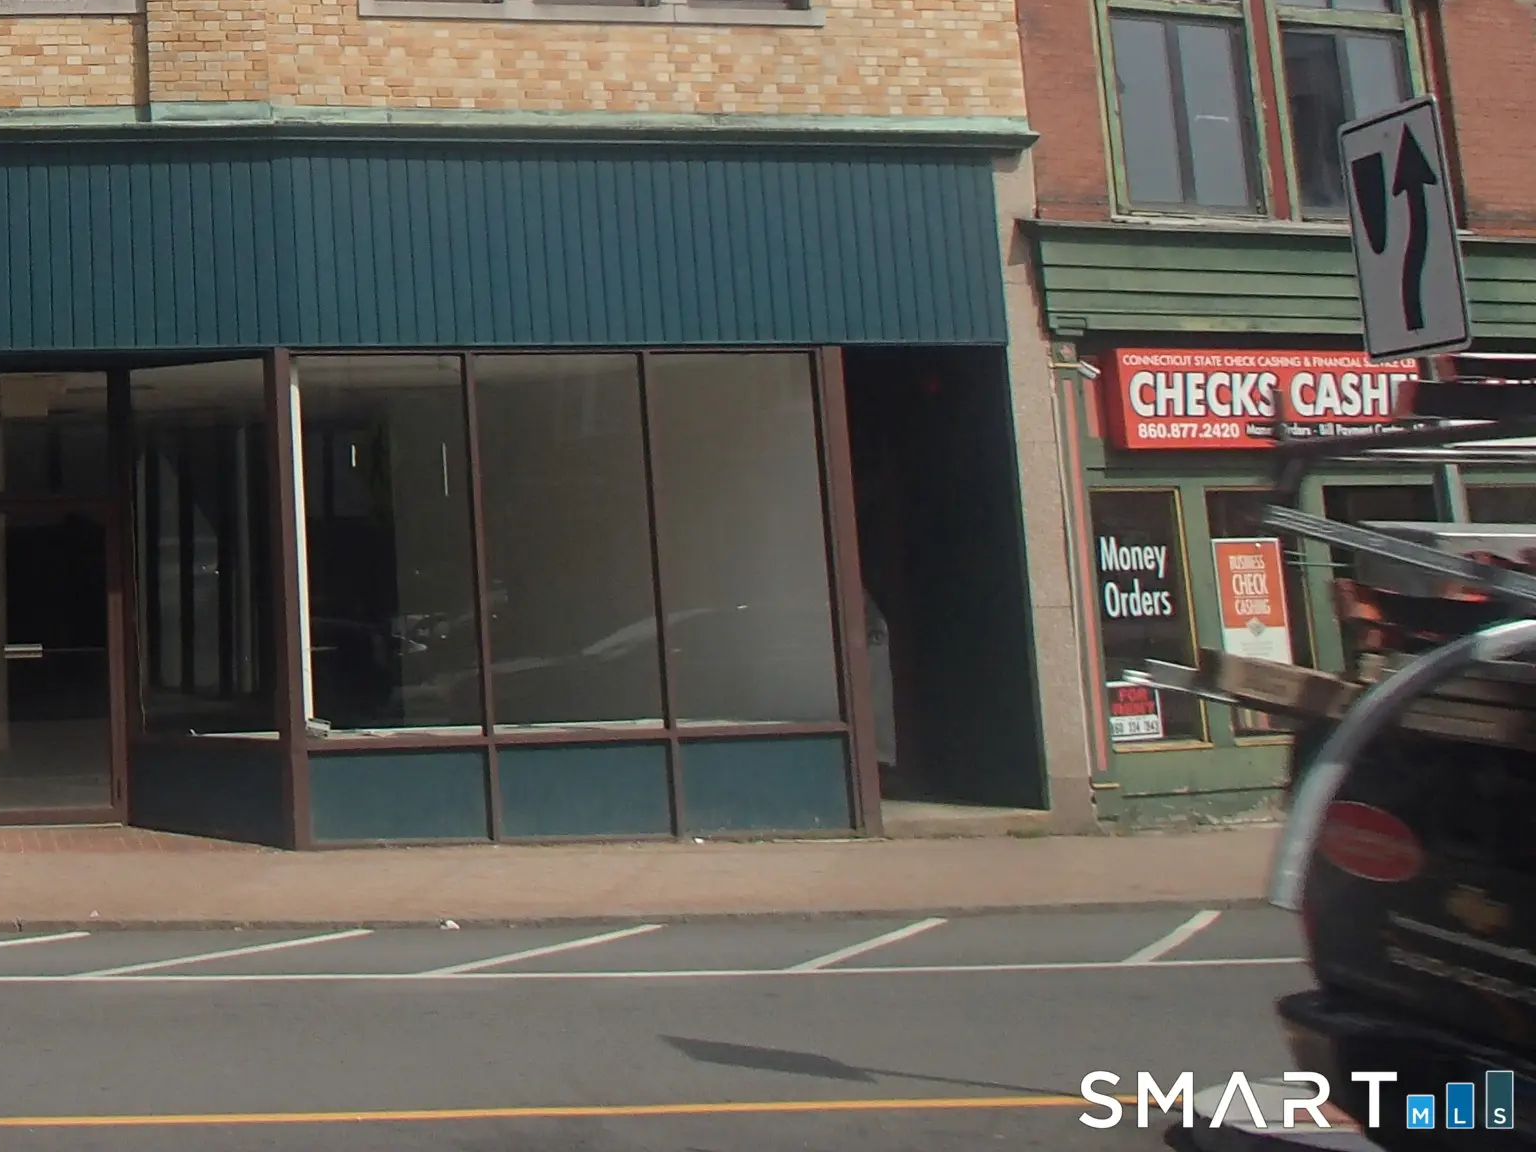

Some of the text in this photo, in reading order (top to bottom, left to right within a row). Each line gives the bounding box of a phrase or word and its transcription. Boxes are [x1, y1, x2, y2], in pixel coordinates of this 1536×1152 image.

[1122, 355, 1192, 366] CONNECTICUT
[1195, 355, 1222, 366] STATE
[1224, 356, 1256, 367] CHECK
[1258, 356, 1301, 367] CASHING
[1304, 357, 1311, 367] &
[1312, 357, 1362, 368] FINANCIAL
[1129, 371, 1419, 417] CHECKS CASH
[1138, 423, 1240, 438] 860.877.2420
[1246, 424, 1274, 436] Mone
[1318, 422, 1335, 436] Bill
[1099, 536, 1167, 579] Money
[1232, 573, 1269, 595] CHECK
[1104, 578, 1173, 618] Orders
[1234, 599, 1271, 615] CASHING
